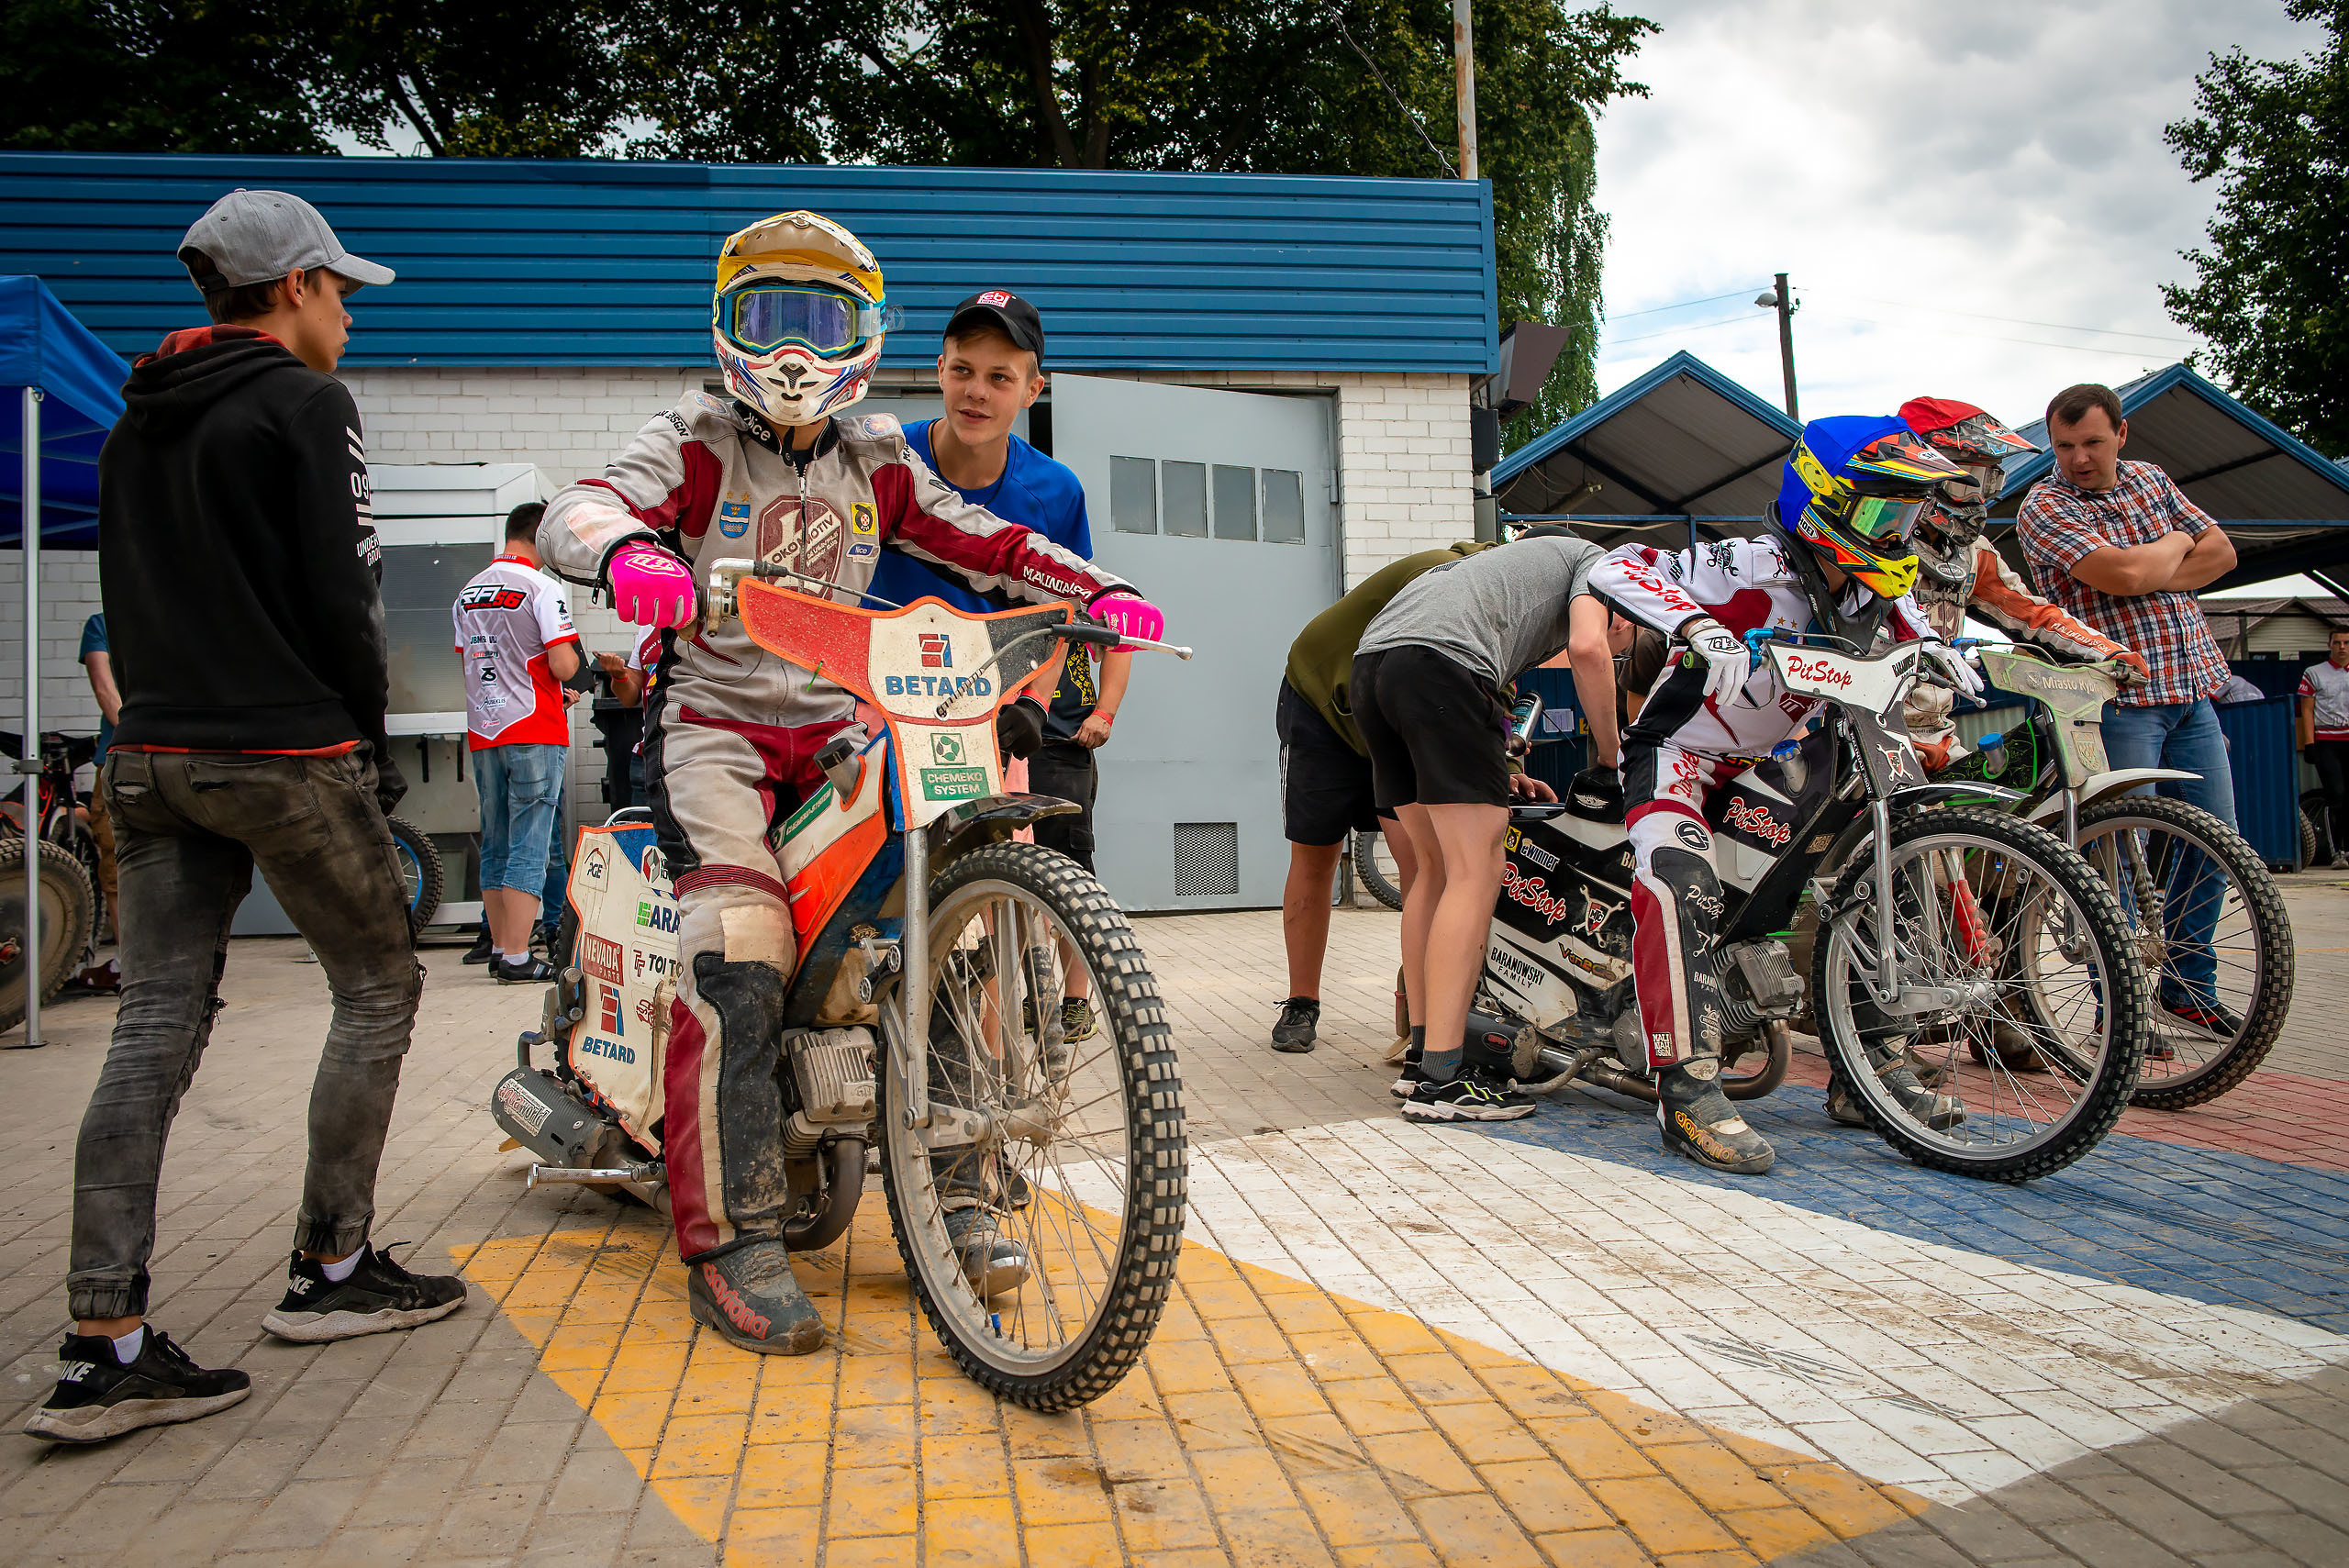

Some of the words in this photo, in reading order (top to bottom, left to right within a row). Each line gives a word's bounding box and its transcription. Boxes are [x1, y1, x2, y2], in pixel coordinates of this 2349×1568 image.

[854, 545, 868, 554] Nice
[1787, 655, 1853, 691] PitStop
[2042, 676, 2077, 690] Miasto
[885, 675, 992, 696] BETARD
[927, 772, 983, 784] CHEMEKO
[934, 784, 981, 795] SYSTEM
[1722, 796, 1791, 849] PitStop
[586, 862, 604, 879] PGE
[586, 936, 619, 972] NEVADA
[648, 953, 667, 975] TOI
[599, 968, 620, 984] PARTS
[1497, 965, 1533, 989] FAMILY
[581, 1035, 636, 1065] BETARD
[1675, 1110, 1737, 1163] daytona
[702, 1262, 772, 1340] daytona
